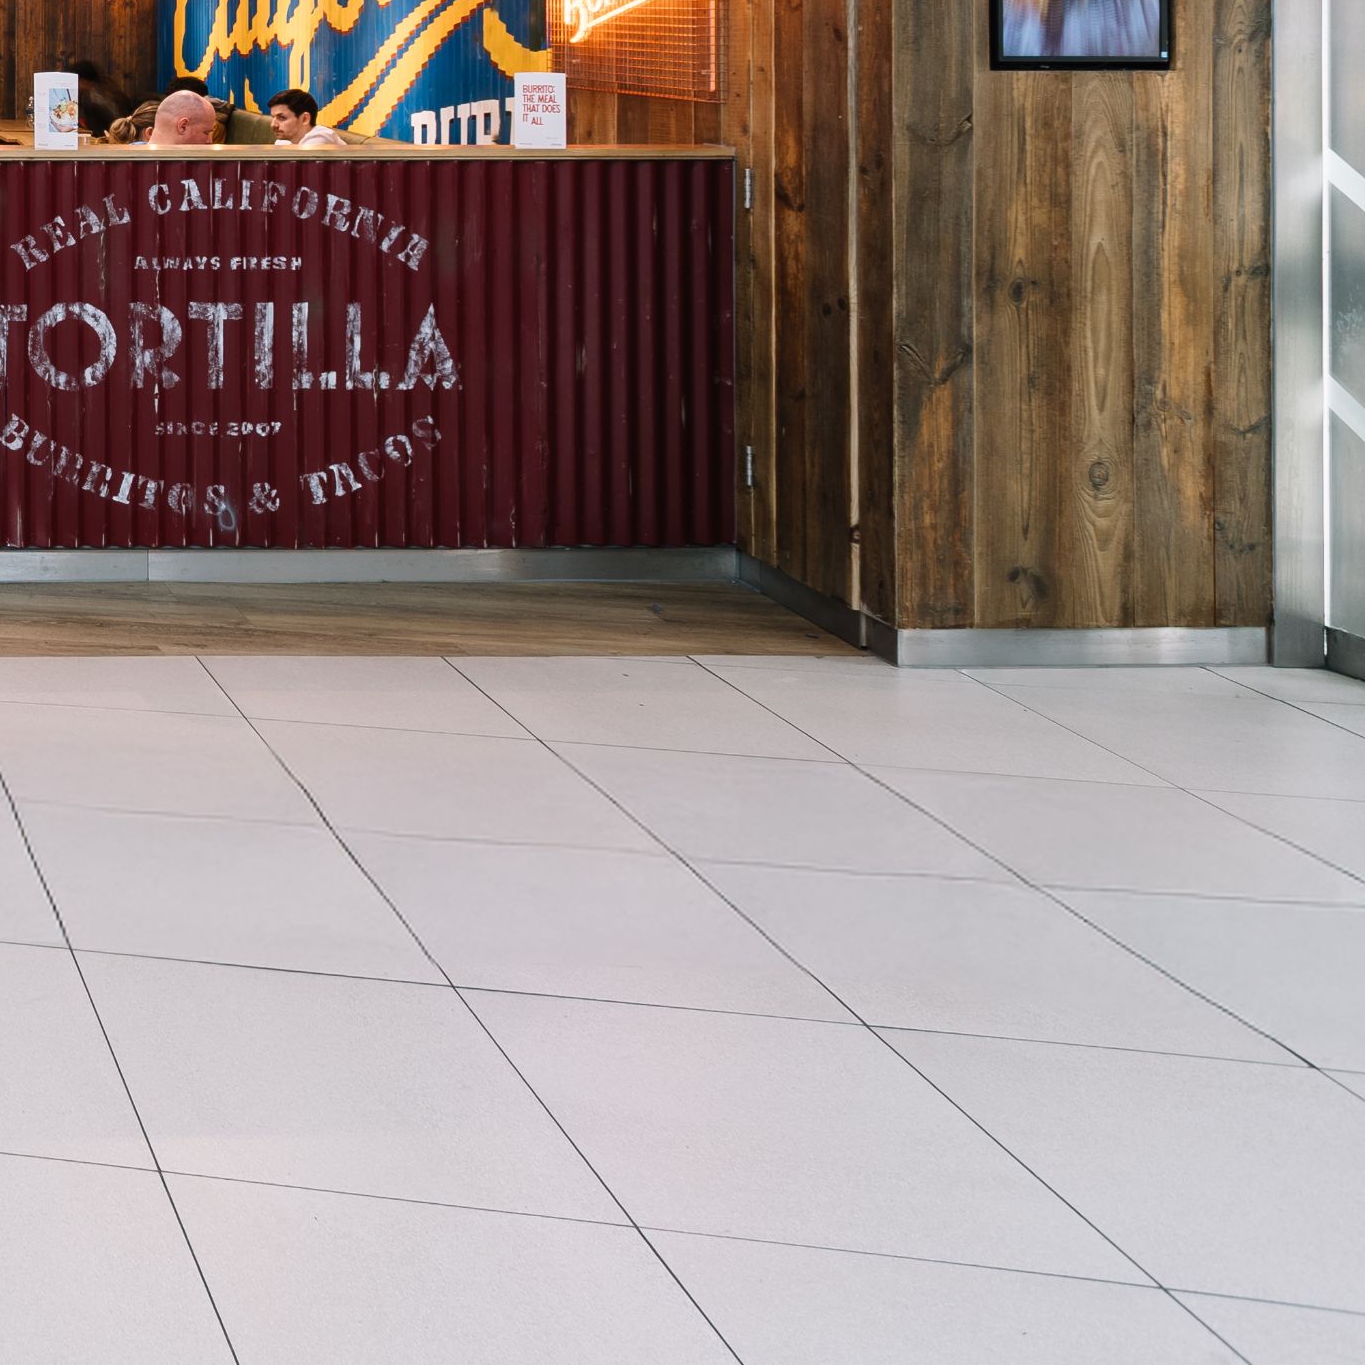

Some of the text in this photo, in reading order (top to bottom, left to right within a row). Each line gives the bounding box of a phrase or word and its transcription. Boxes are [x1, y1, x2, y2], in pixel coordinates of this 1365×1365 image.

[523, 94, 557, 103] THE MEAL
[522, 104, 561, 114] THAT DOES
[523, 113, 545, 126] IT ALL
[10, 177, 431, 273] REAL CALIFORNIA
[134, 255, 303, 271] ALWAYS FRESH
[154, 420, 283, 437] SINCE 2007
[248, 481, 281, 515] &
[300, 414, 443, 506] TACOS
